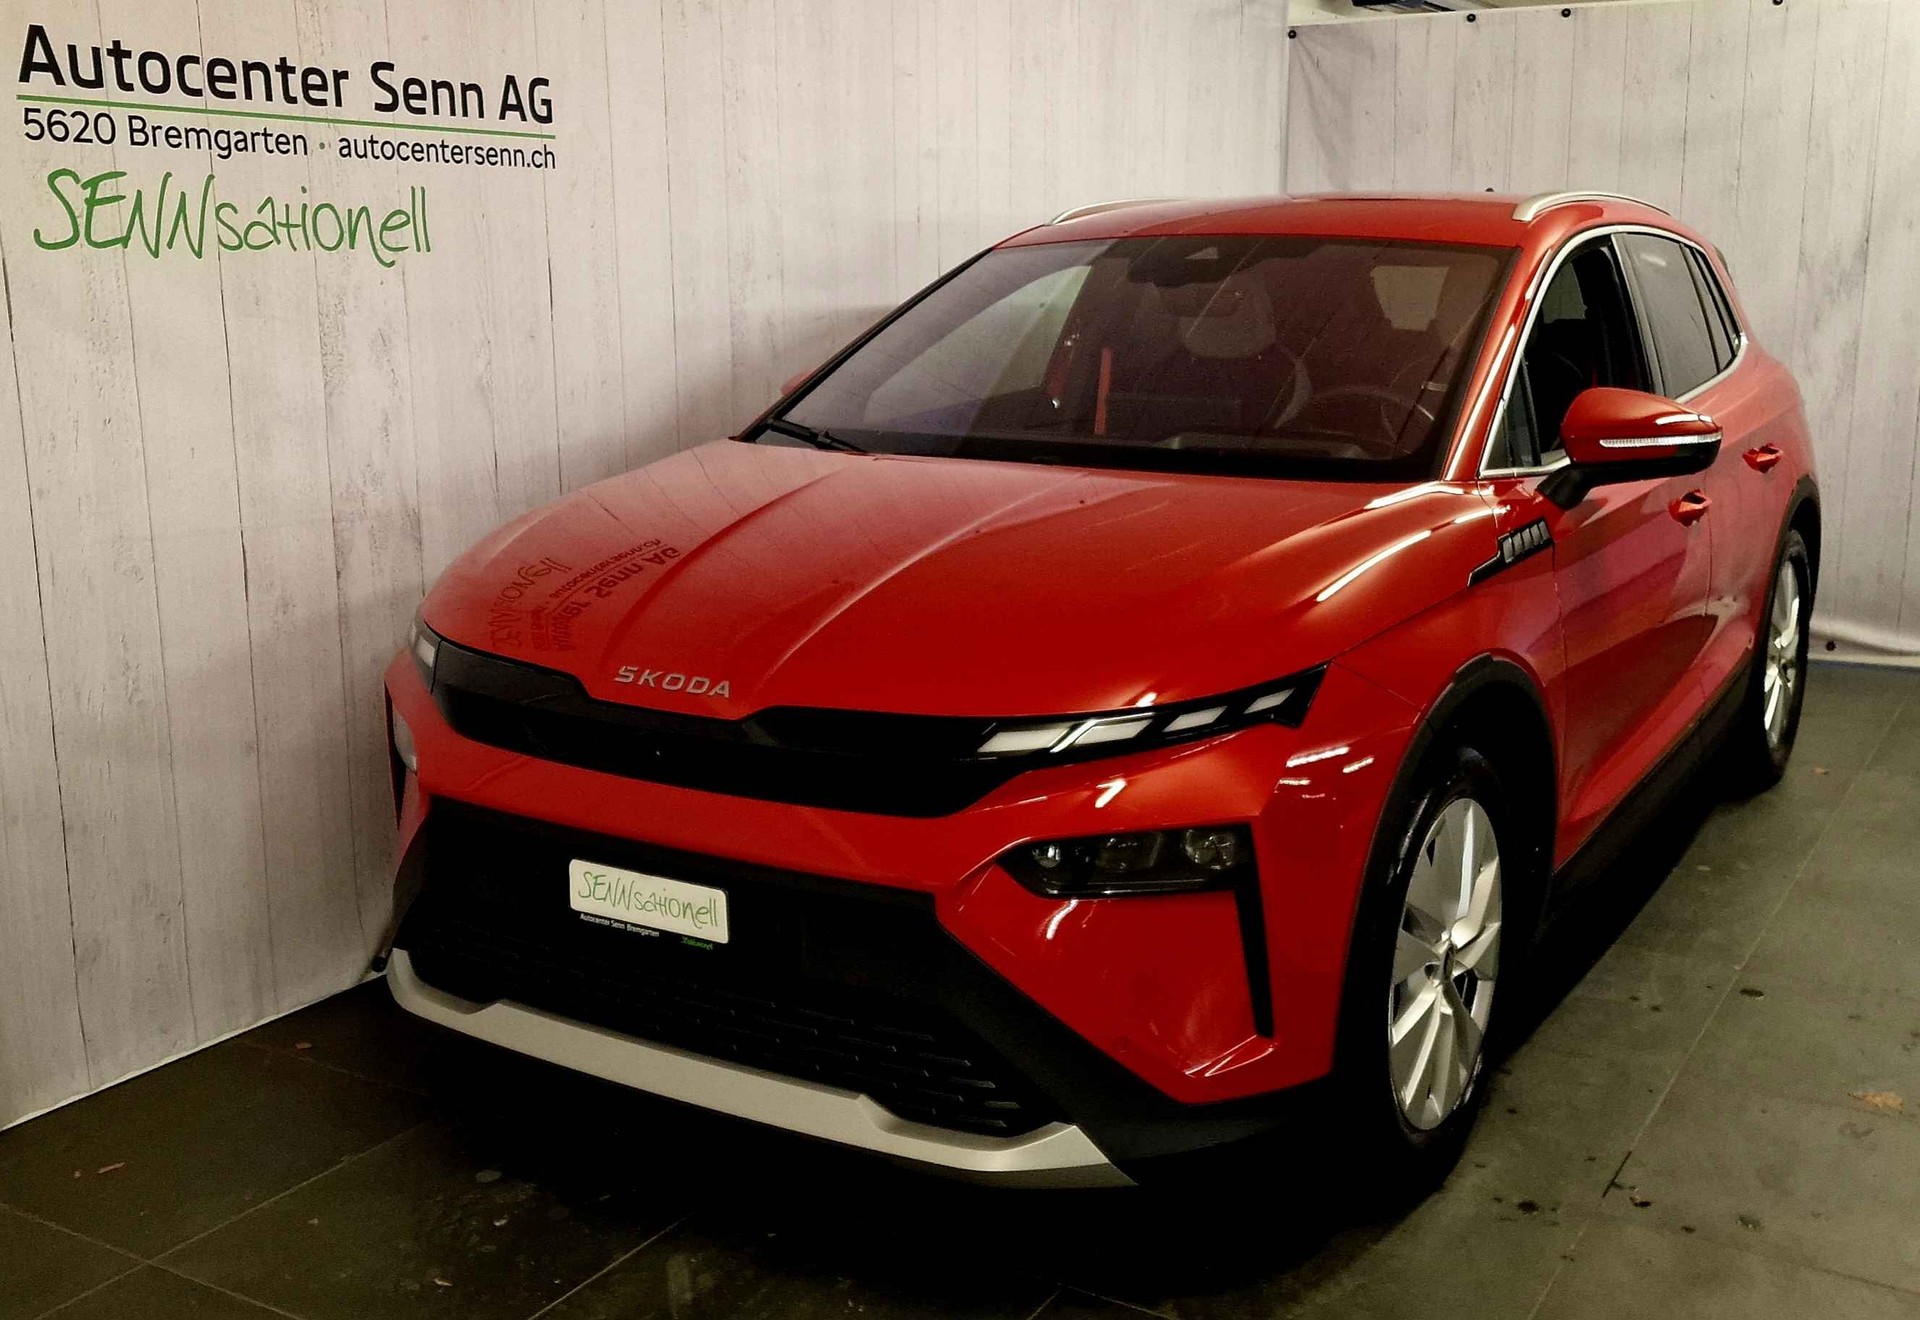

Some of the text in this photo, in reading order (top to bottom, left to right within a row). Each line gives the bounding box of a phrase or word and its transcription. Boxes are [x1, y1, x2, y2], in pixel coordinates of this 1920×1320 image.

[18, 23, 553, 124] Autocenter Senn AG
[23, 107, 556, 169] 5620 Bremgarten autocentersenn.ch
[34, 168, 431, 268] SENNsationell
[577, 871, 719, 930] SENNsationell
[580, 912, 660, 938] Autocenter Senn Bremgarten
